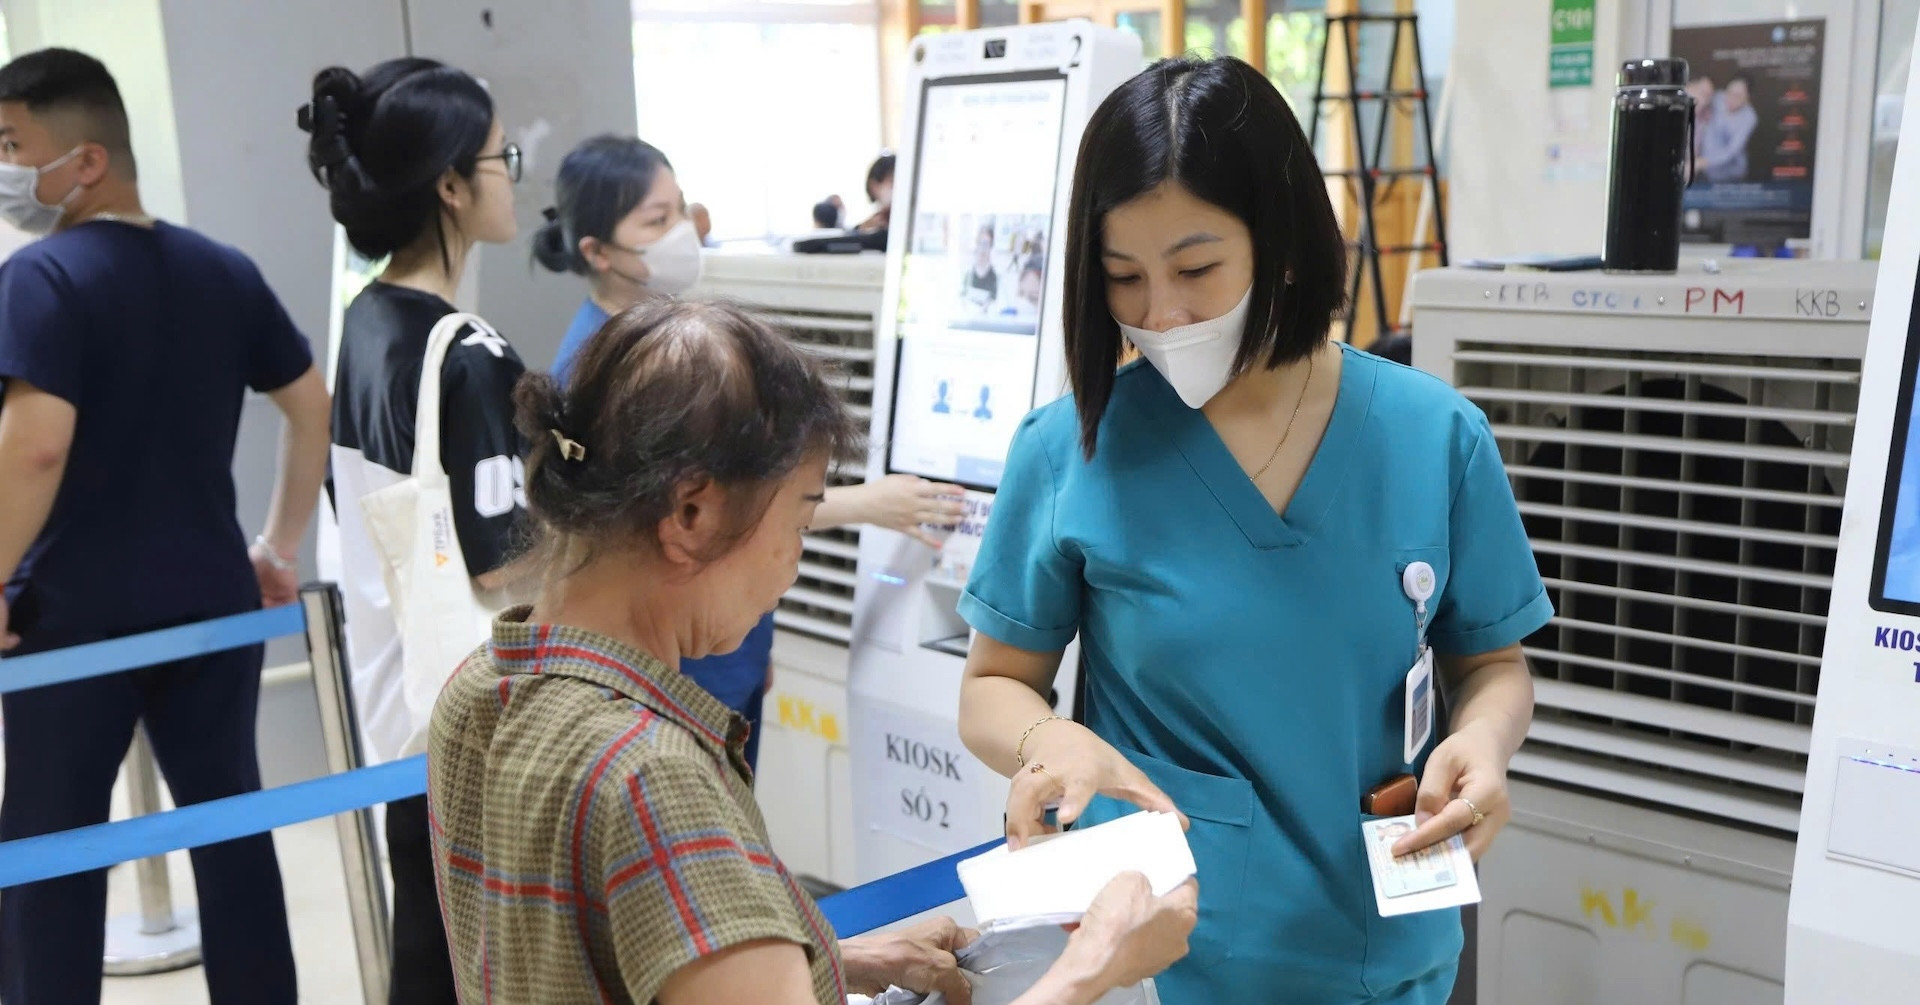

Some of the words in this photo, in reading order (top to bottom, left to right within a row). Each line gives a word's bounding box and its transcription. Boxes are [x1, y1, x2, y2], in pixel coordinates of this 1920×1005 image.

[1069, 35, 1082, 68] 2
[1684, 287, 1745, 314] PM
[1794, 289, 1842, 317] KKB
[885, 733, 962, 782] KIOSK
[901, 786, 931, 822] SỐ
[939, 801, 949, 828] 2
